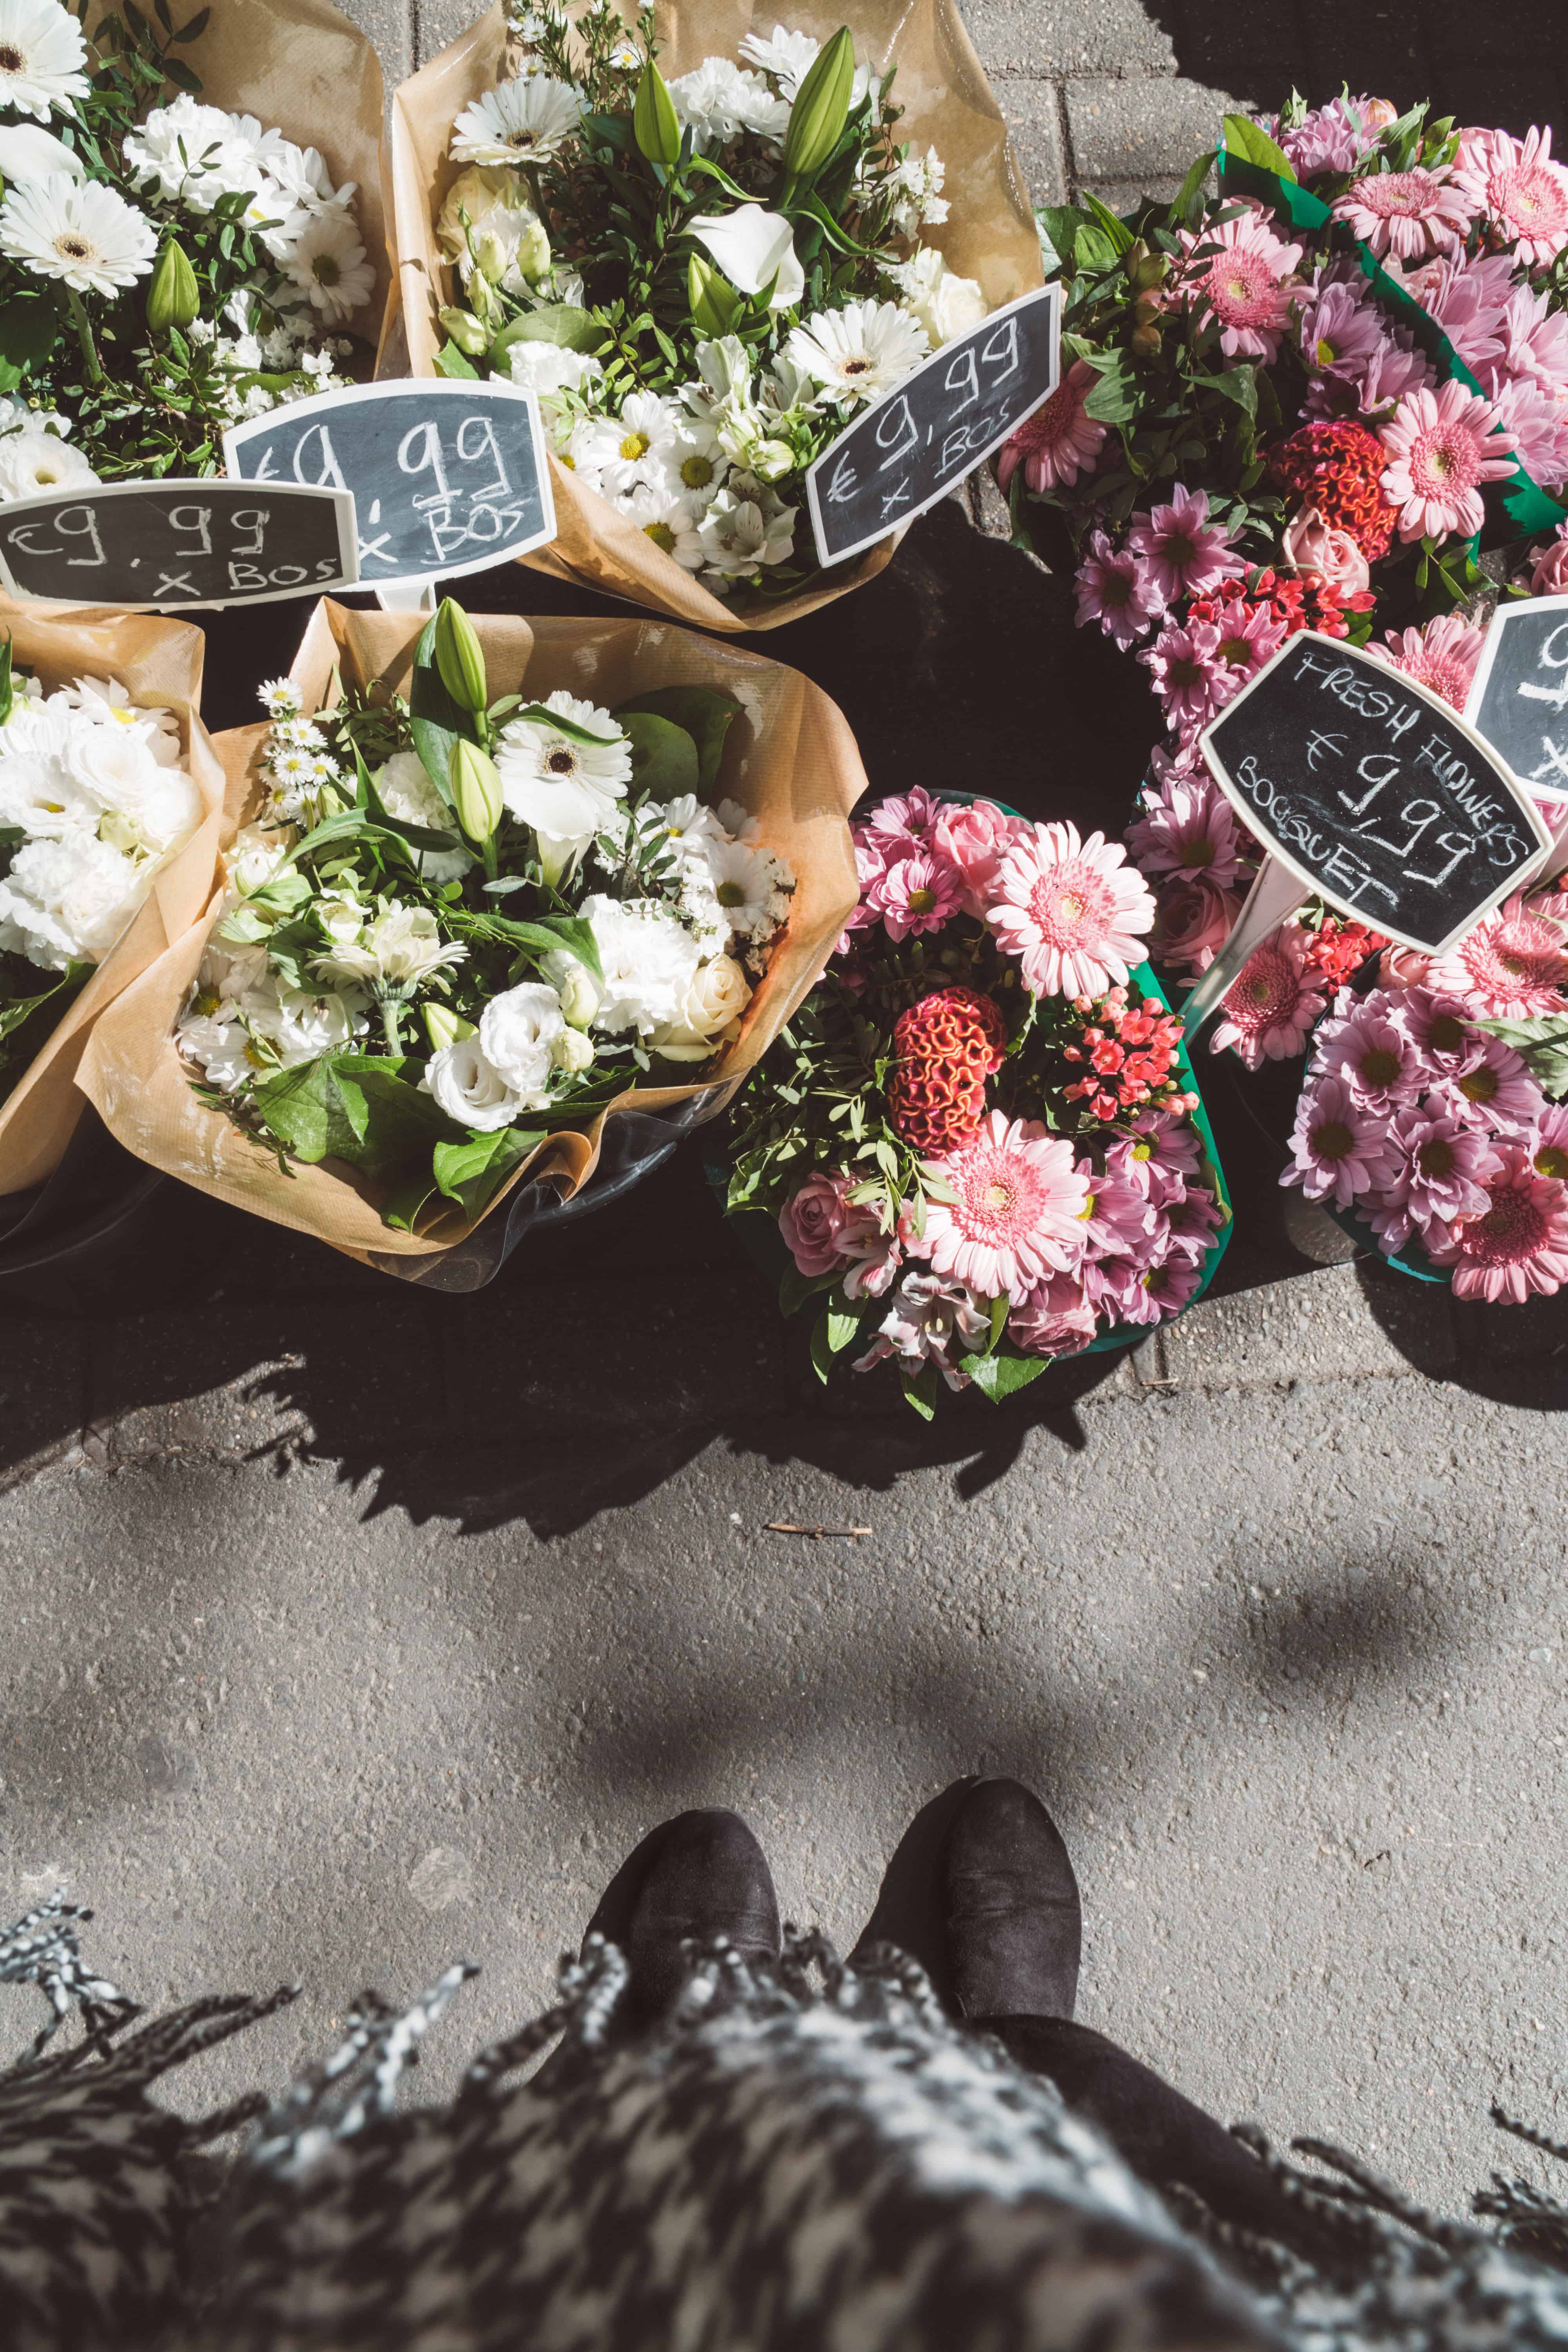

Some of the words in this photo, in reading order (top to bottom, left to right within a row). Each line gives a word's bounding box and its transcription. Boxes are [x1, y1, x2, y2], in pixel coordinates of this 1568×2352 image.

[934, 397, 1011, 479] BOS
[423, 497, 535, 562] BOS
[228, 557, 338, 590] BOS
[1294, 652, 1421, 744] FRESH
